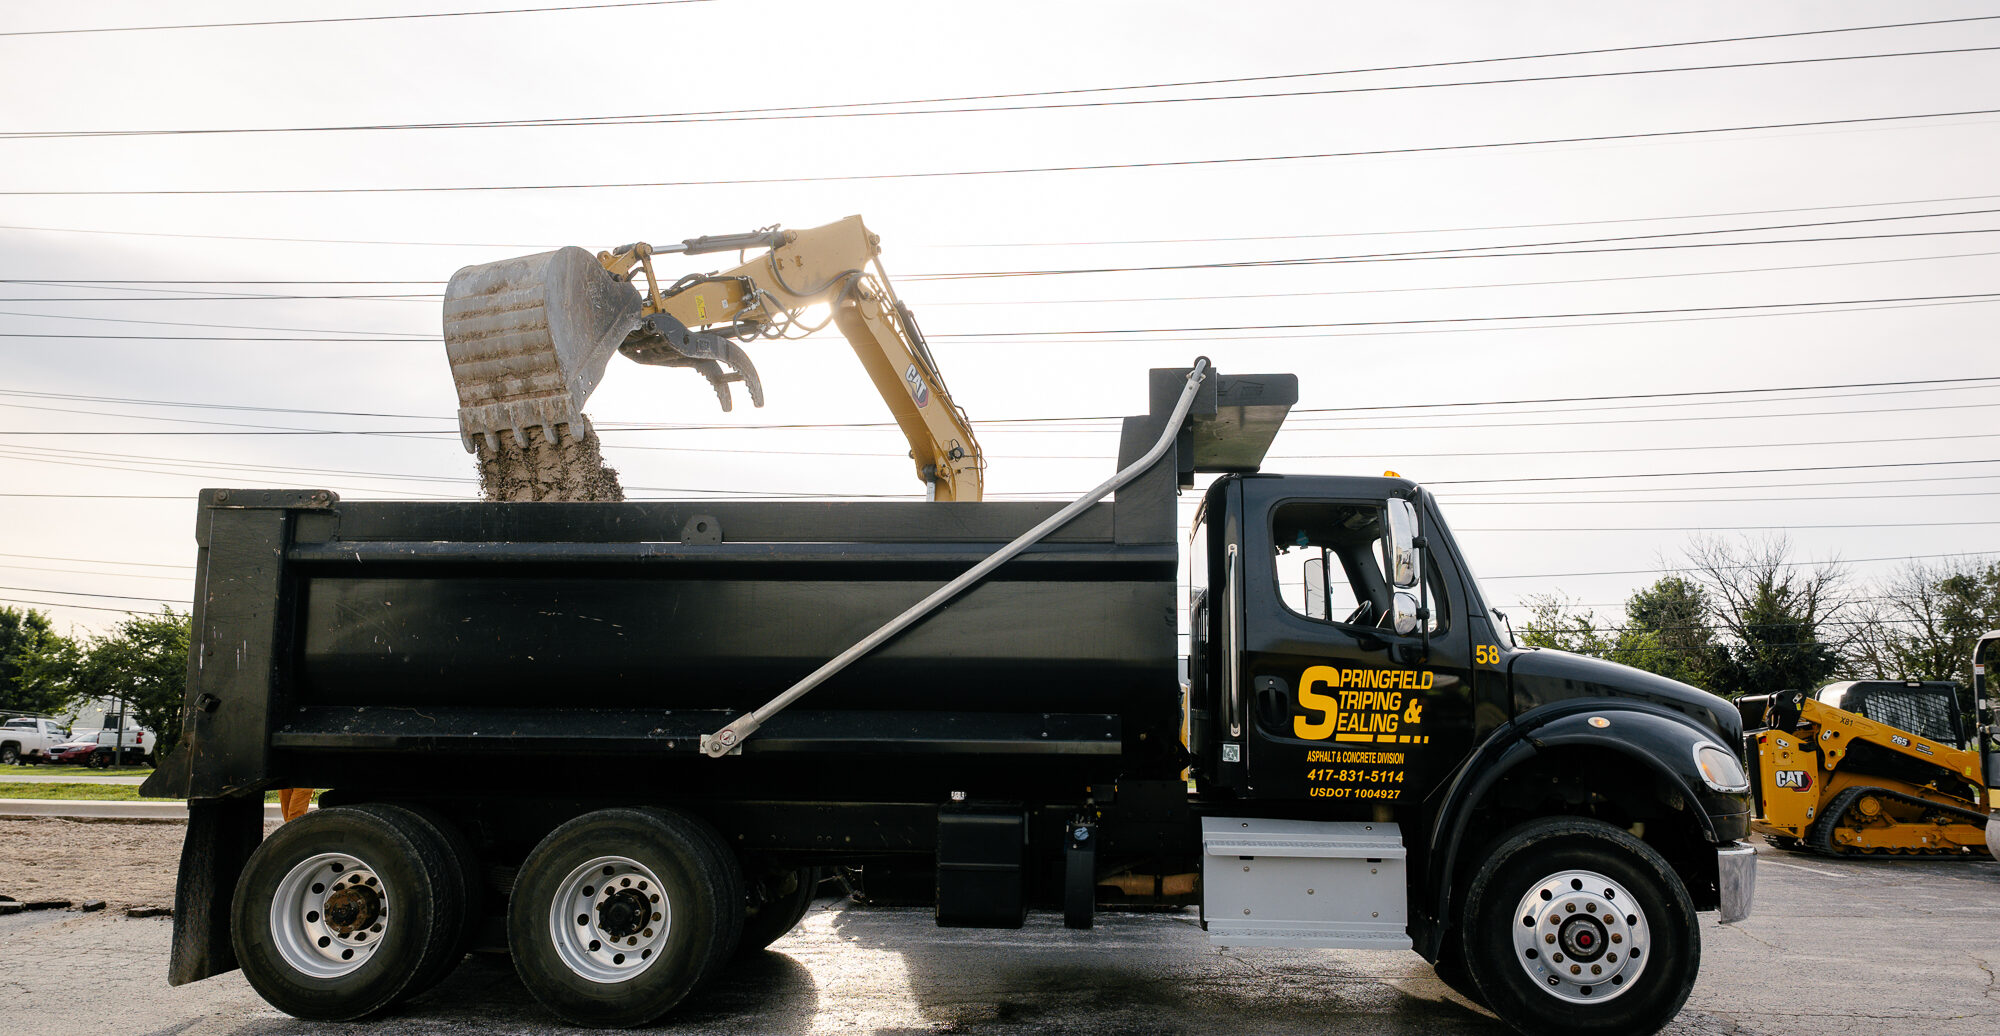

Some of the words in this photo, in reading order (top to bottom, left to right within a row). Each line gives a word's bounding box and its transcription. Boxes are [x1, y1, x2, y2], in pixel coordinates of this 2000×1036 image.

[905, 363, 928, 399] CAT
[1475, 644, 1501, 665] 58
[1403, 698, 1423, 724] &
[1840, 716, 1854, 727] X81
[1891, 734, 1909, 747] 265
[1306, 750, 1337, 763] ASPHALT
[1336, 751, 1342, 763] &
[1342, 751, 1377, 764] CONCRETE
[1377, 752, 1405, 765] DIVISION
[1307, 768, 1405, 783] 417-831-5114
[1776, 770, 1804, 788] CAT
[1309, 787, 1352, 798] USDOT
[1355, 789, 1401, 799] 1004927
